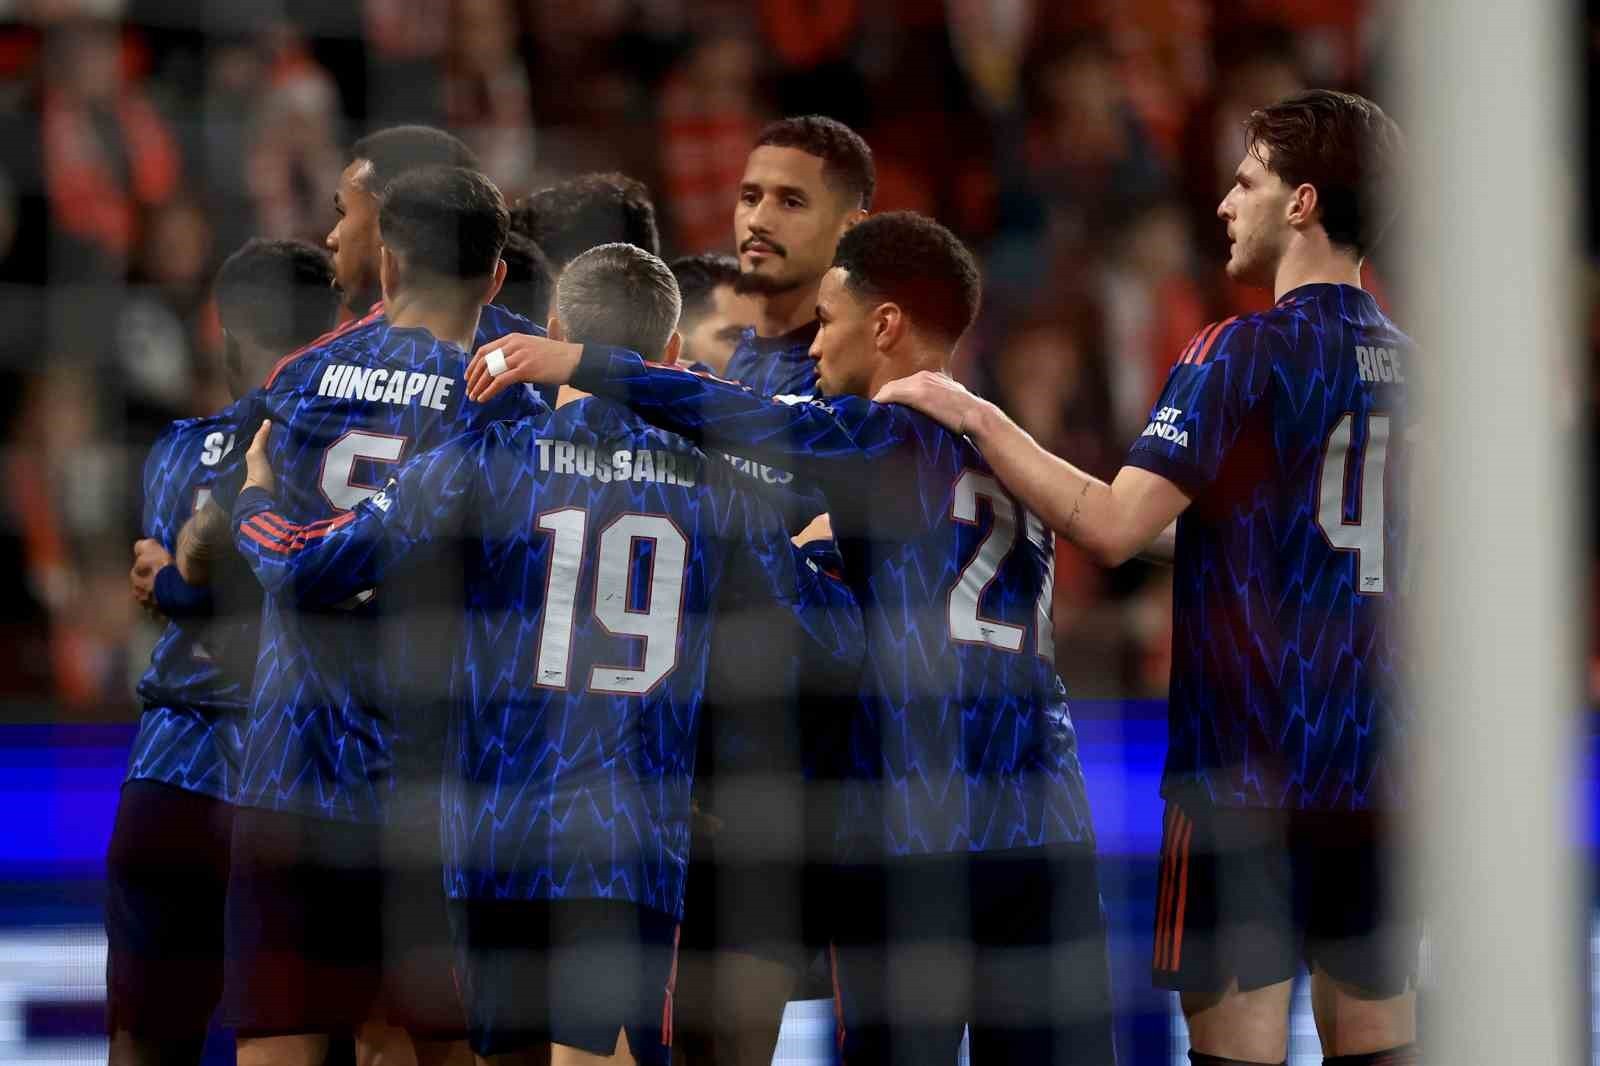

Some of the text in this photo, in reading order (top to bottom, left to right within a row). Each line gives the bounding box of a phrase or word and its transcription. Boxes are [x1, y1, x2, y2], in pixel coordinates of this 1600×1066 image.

[317, 364, 455, 410] HINCAPIE
[1355, 346, 1405, 384] RICE
[1141, 421, 1189, 448] ANDA
[1154, 406, 1183, 424] SIT
[535, 439, 696, 487] TROSSARD
[1315, 412, 1391, 596] 4
[533, 505, 690, 697] 19
